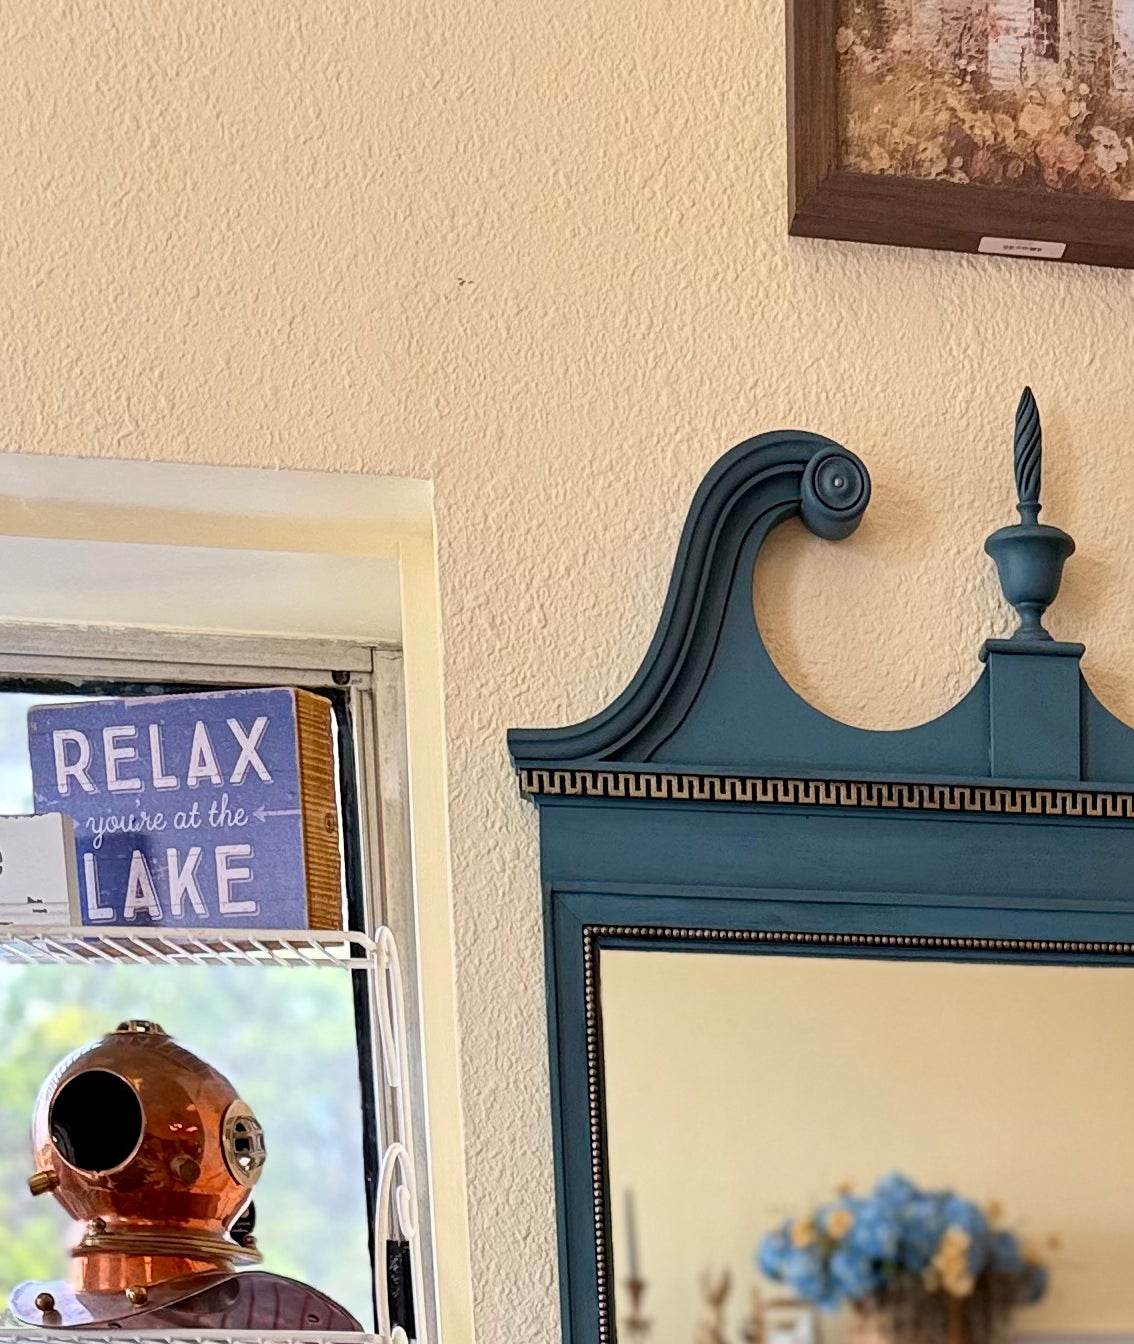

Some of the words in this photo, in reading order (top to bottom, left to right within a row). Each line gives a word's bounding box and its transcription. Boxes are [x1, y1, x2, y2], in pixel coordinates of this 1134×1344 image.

[53, 716, 273, 795] RELAX
[86, 799, 167, 849] you're
[174, 803, 203, 829] at
[208, 794, 249, 827] the
[83, 844, 259, 921] LAKE
